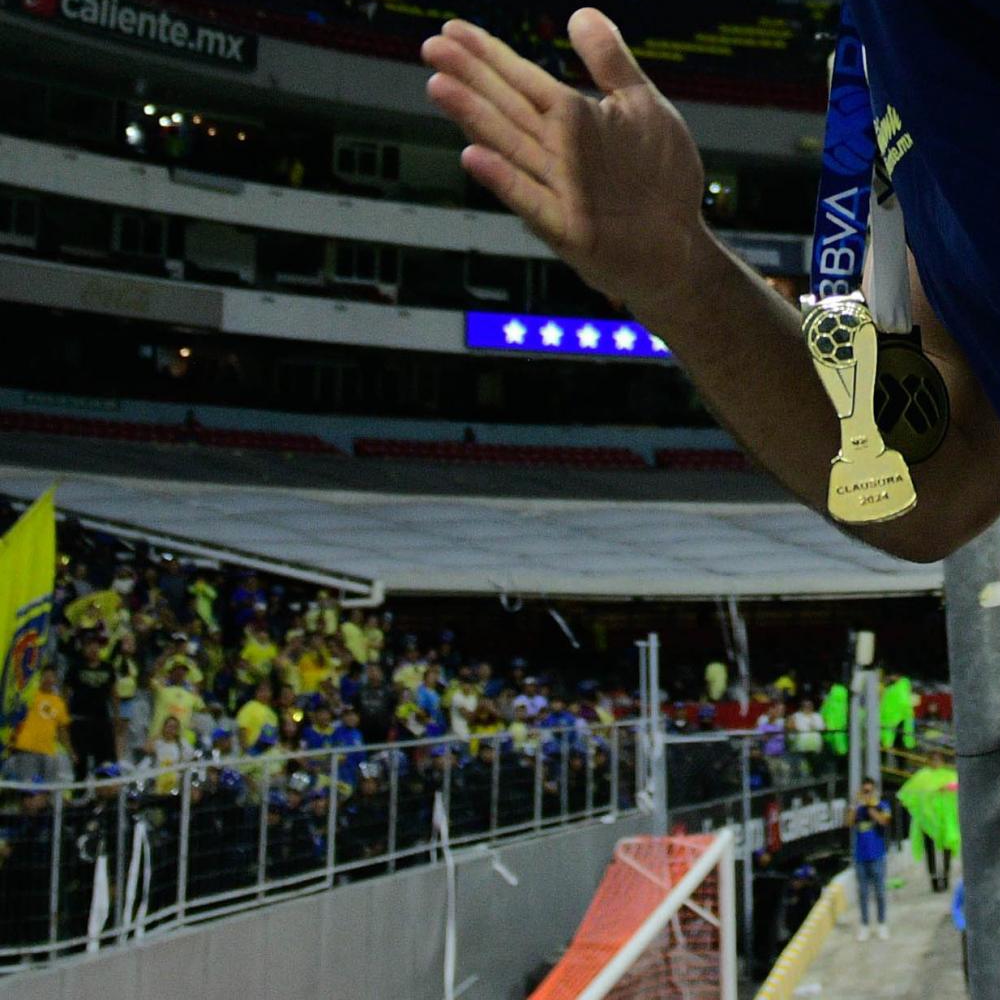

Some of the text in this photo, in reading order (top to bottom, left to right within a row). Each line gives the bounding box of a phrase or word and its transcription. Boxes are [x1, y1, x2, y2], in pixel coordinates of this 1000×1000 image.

[818, 186, 859, 298] BBVA
[836, 475, 903, 494] CLAUSURA
[861, 493, 888, 505] 2024
